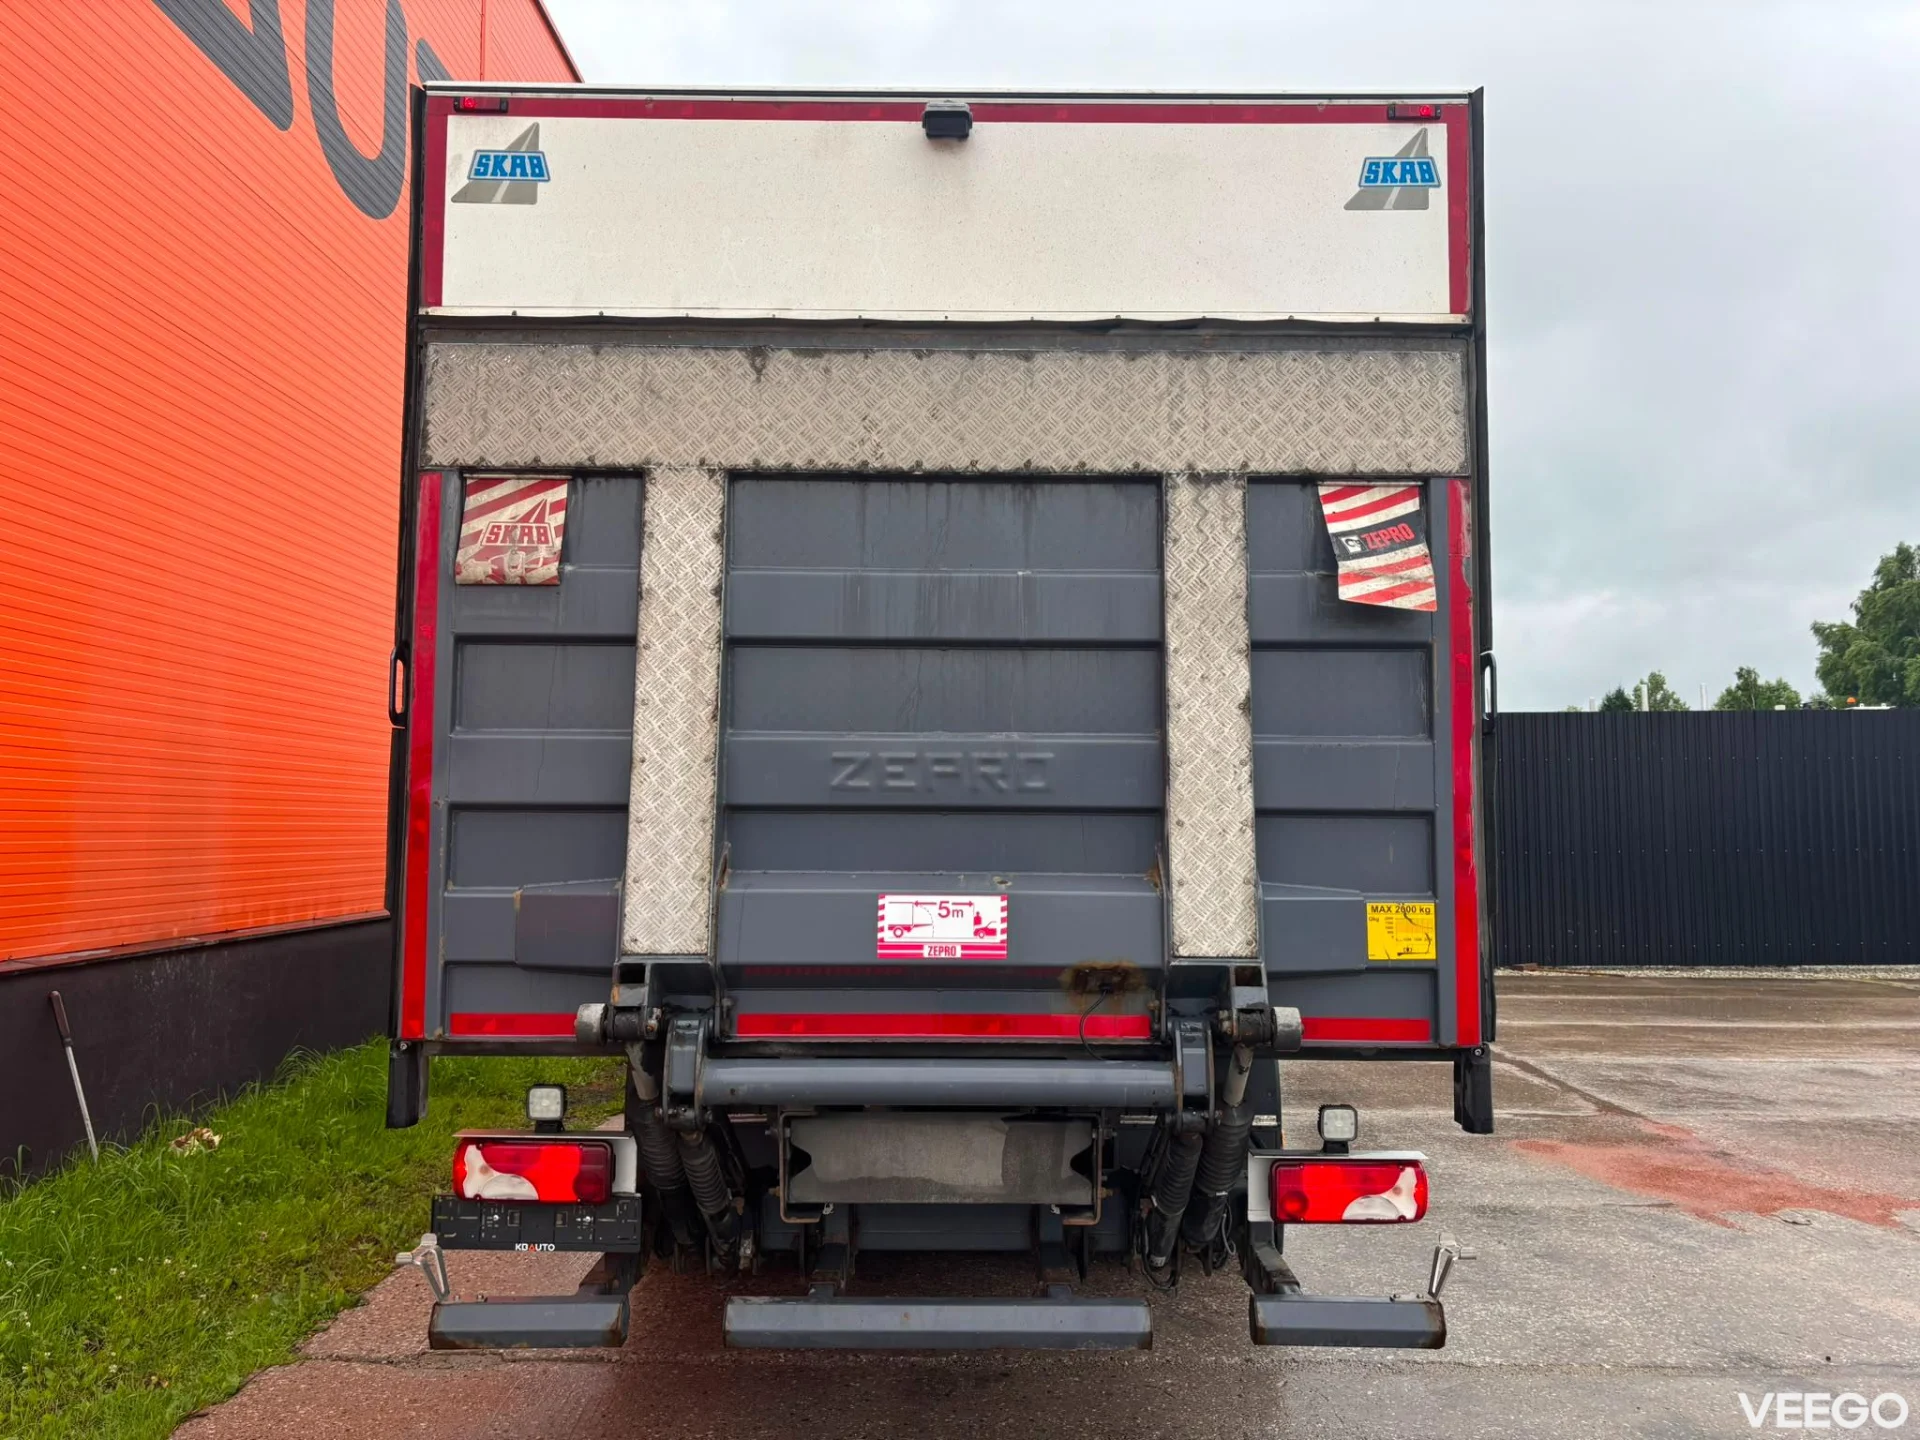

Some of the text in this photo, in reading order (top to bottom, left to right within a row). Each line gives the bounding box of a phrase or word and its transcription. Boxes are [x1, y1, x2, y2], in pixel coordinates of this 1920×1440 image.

[473, 154, 546, 178] SKAB
[1363, 160, 1436, 184] SKAB
[484, 524, 551, 545] SKAB
[1361, 522, 1416, 550] ZEPRO
[1371, 905, 1392, 913] MAX
[1419, 905, 1431, 915] kg
[927, 945, 957, 957] ZEPRO
